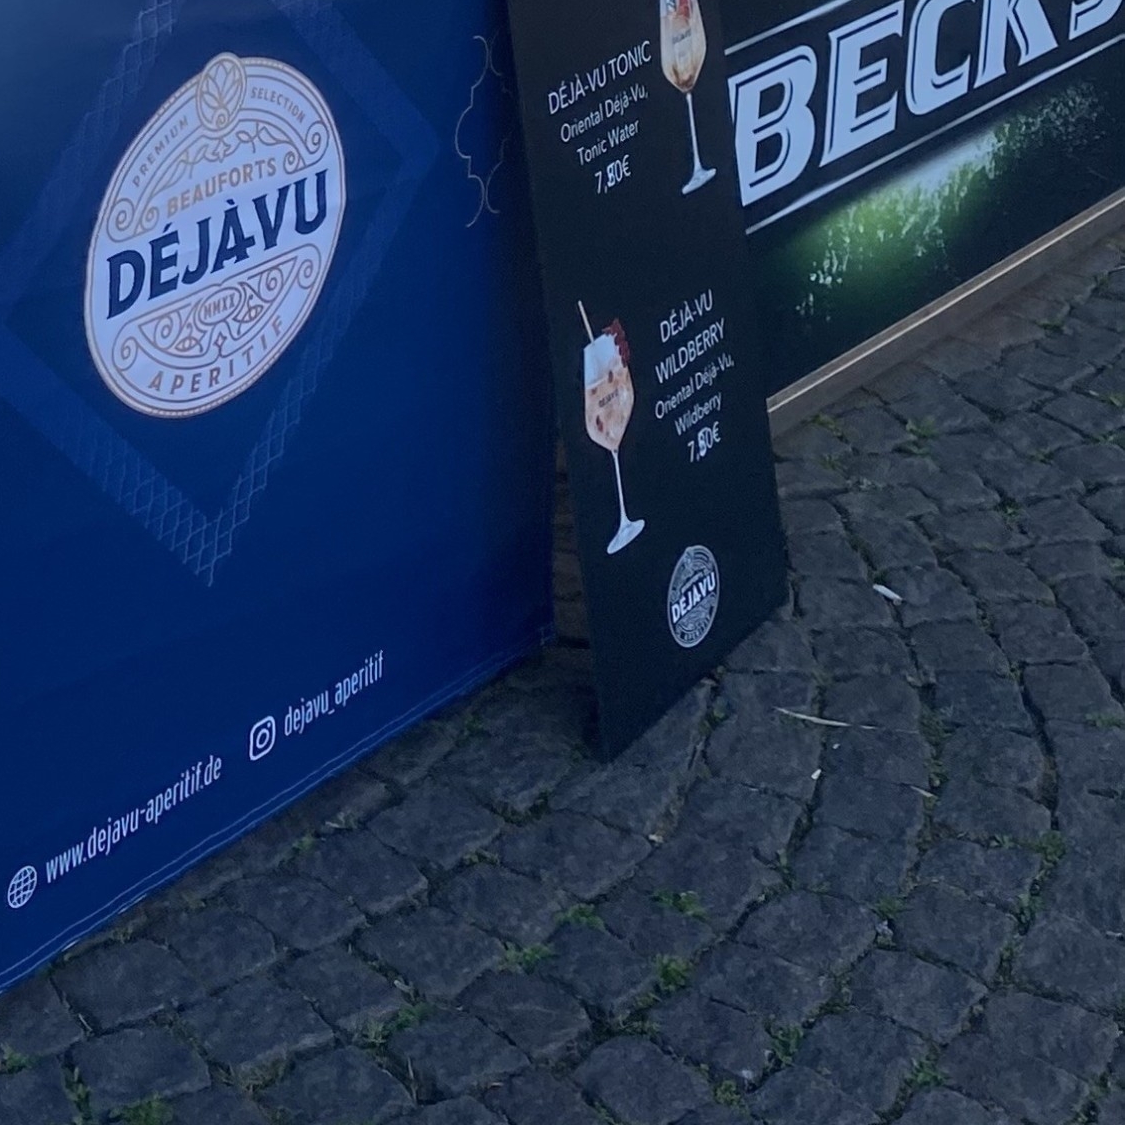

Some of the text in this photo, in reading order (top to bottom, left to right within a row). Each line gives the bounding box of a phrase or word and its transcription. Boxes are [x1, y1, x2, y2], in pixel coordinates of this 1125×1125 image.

[250, 86, 306, 124] SELECTION
[548, 40, 652, 115] DÉJÀ-VU TONIC
[561, 83, 649, 143] Oriental Déjà-Vu,
[577, 120, 640, 166] Tonic Water
[132, 115, 189, 188] PREMIUM
[167, 158, 277, 219] BEAUFORTS
[660, 289, 713, 342] DÉJÀ-VU
[149, 315, 282, 395] APERITIF
[655, 318, 725, 384] WILDBERRY
[655, 377, 694, 419] Oriental
[675, 392, 722, 436] Wildberry
[284, 650, 384, 737] dejavu_aperitif
[45, 755, 222, 883] www.dejavu-aperitif.de
